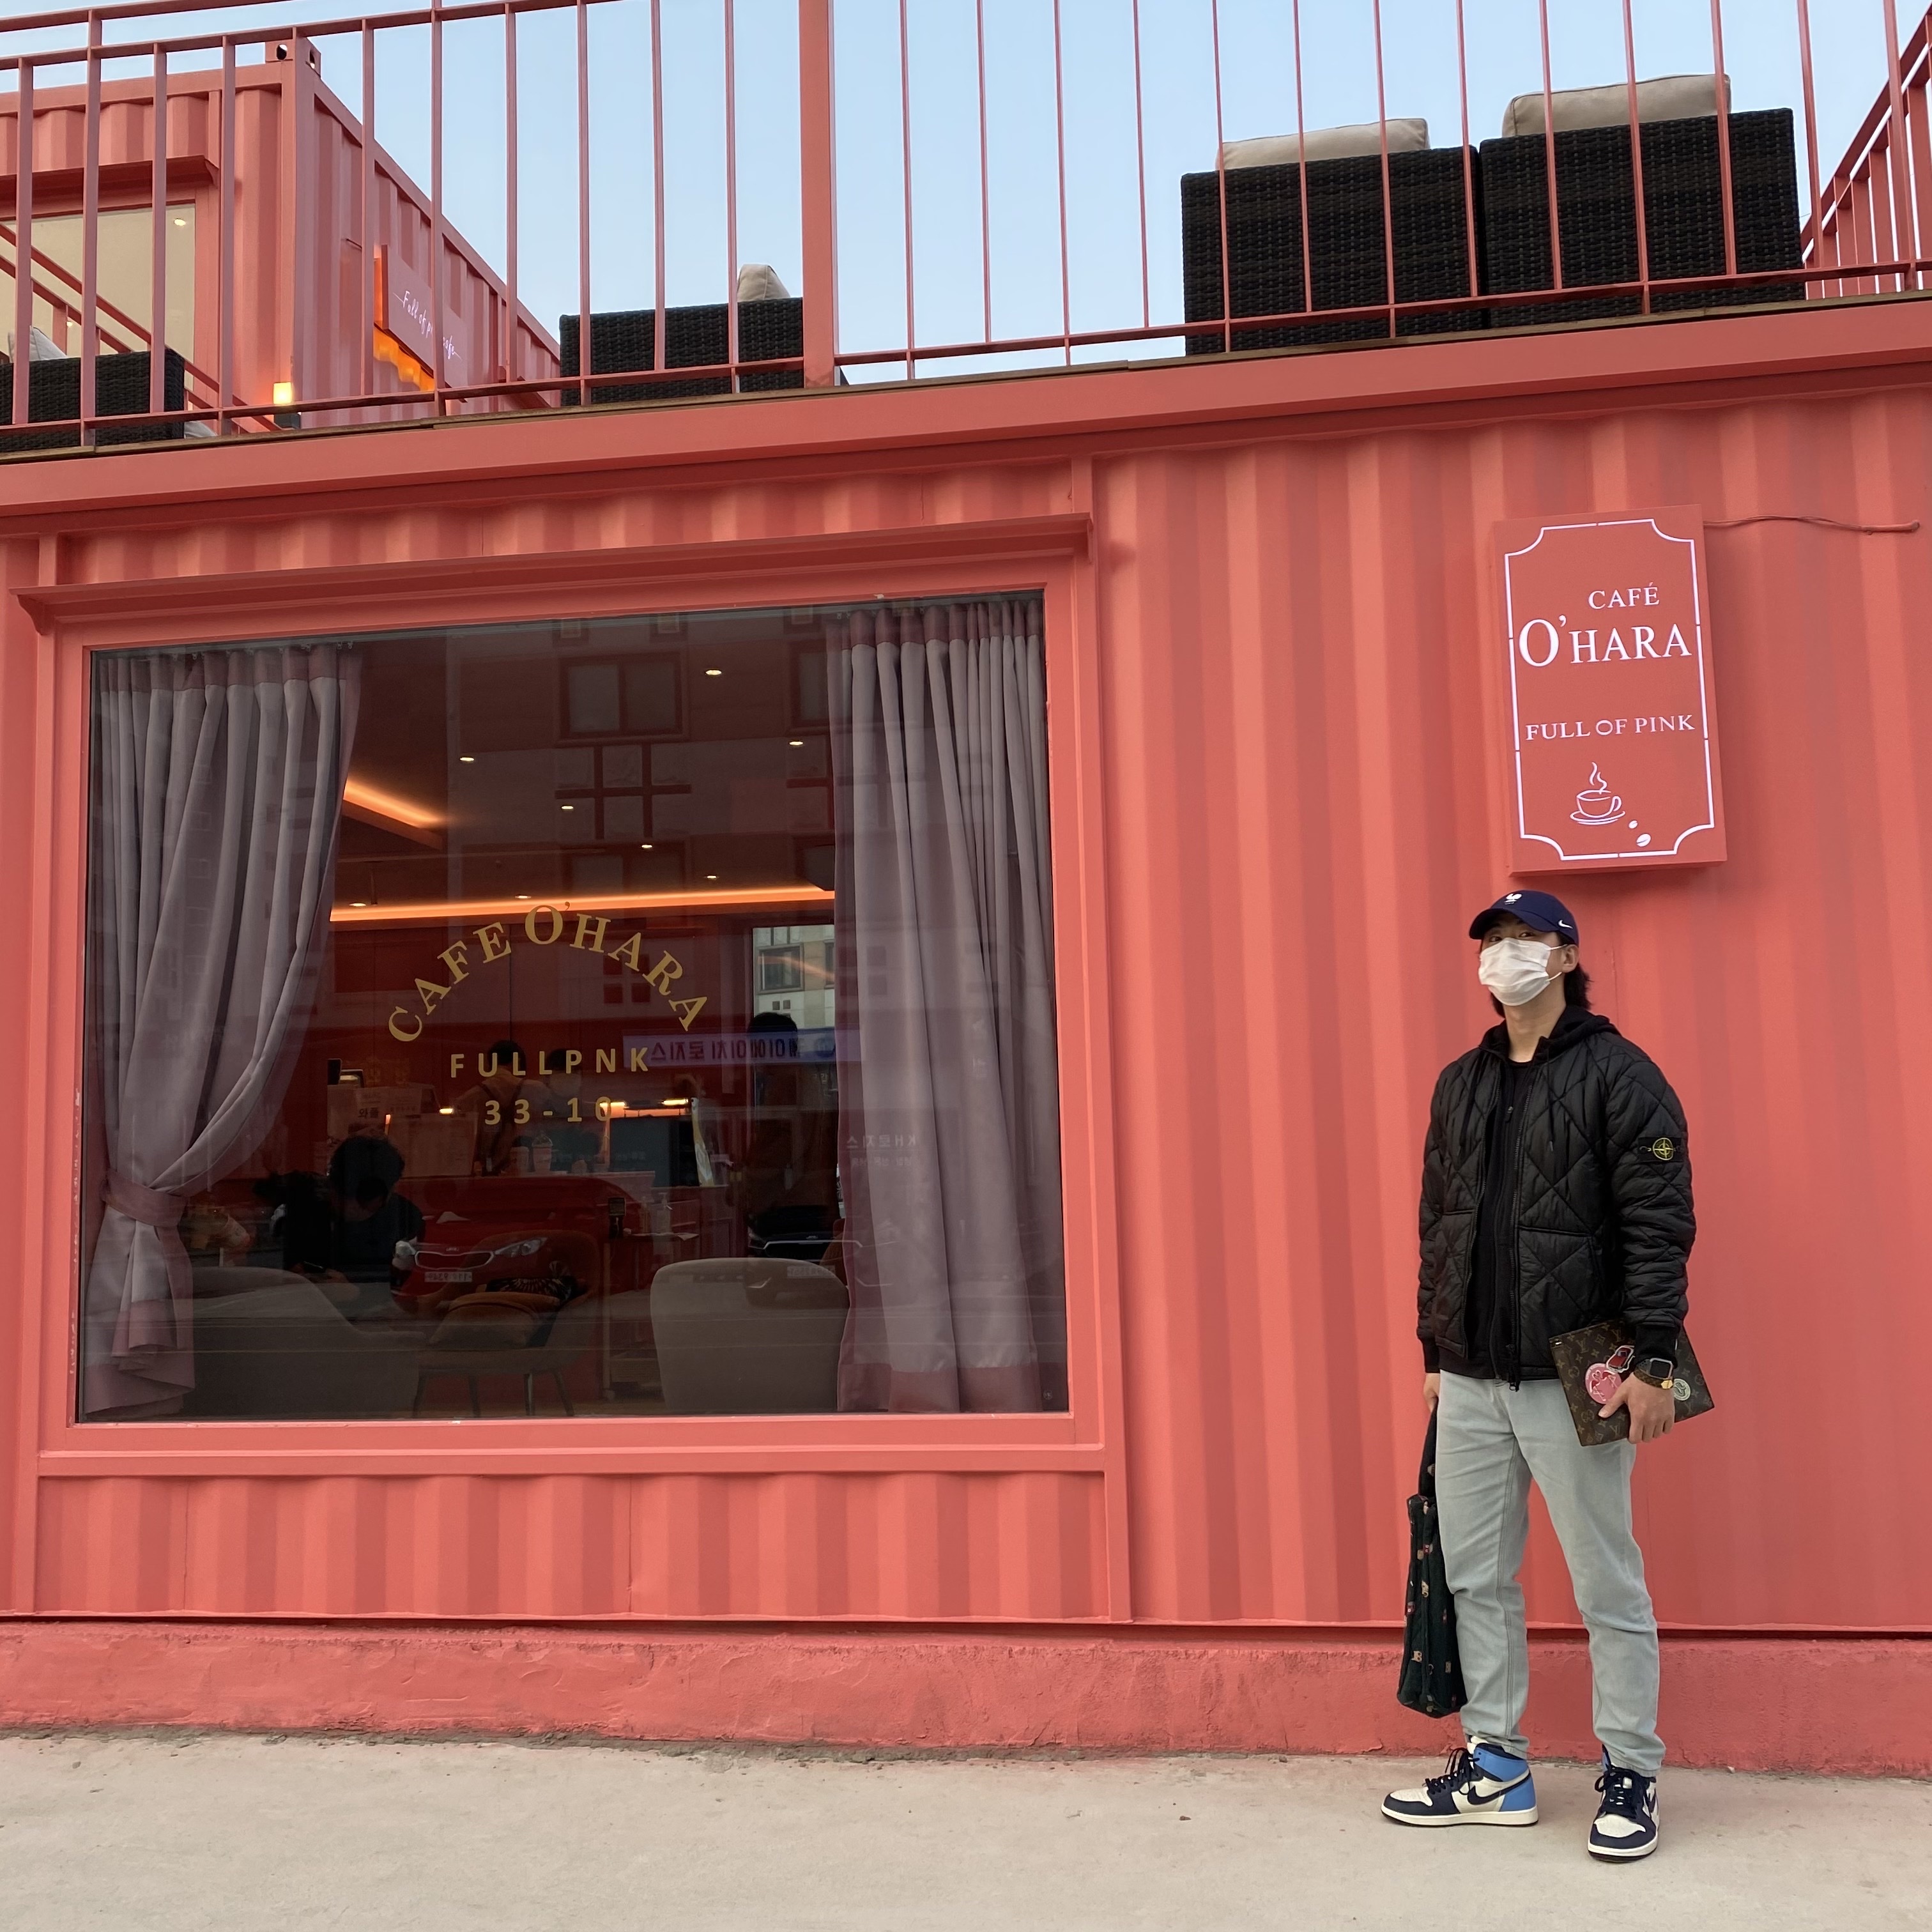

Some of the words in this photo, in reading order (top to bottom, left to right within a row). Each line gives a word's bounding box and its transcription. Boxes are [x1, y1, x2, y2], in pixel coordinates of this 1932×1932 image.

[1588, 581, 1660, 610] CAFÉ
[1518, 614, 1692, 667] O'HARA
[1525, 721, 1591, 741] FULL
[1595, 718, 1628, 736] OF
[1634, 714, 1695, 734] PINK
[388, 921, 512, 1042] CAFE
[524, 901, 708, 1032] O'HARA
[484, 1096, 613, 1125] 33-10
